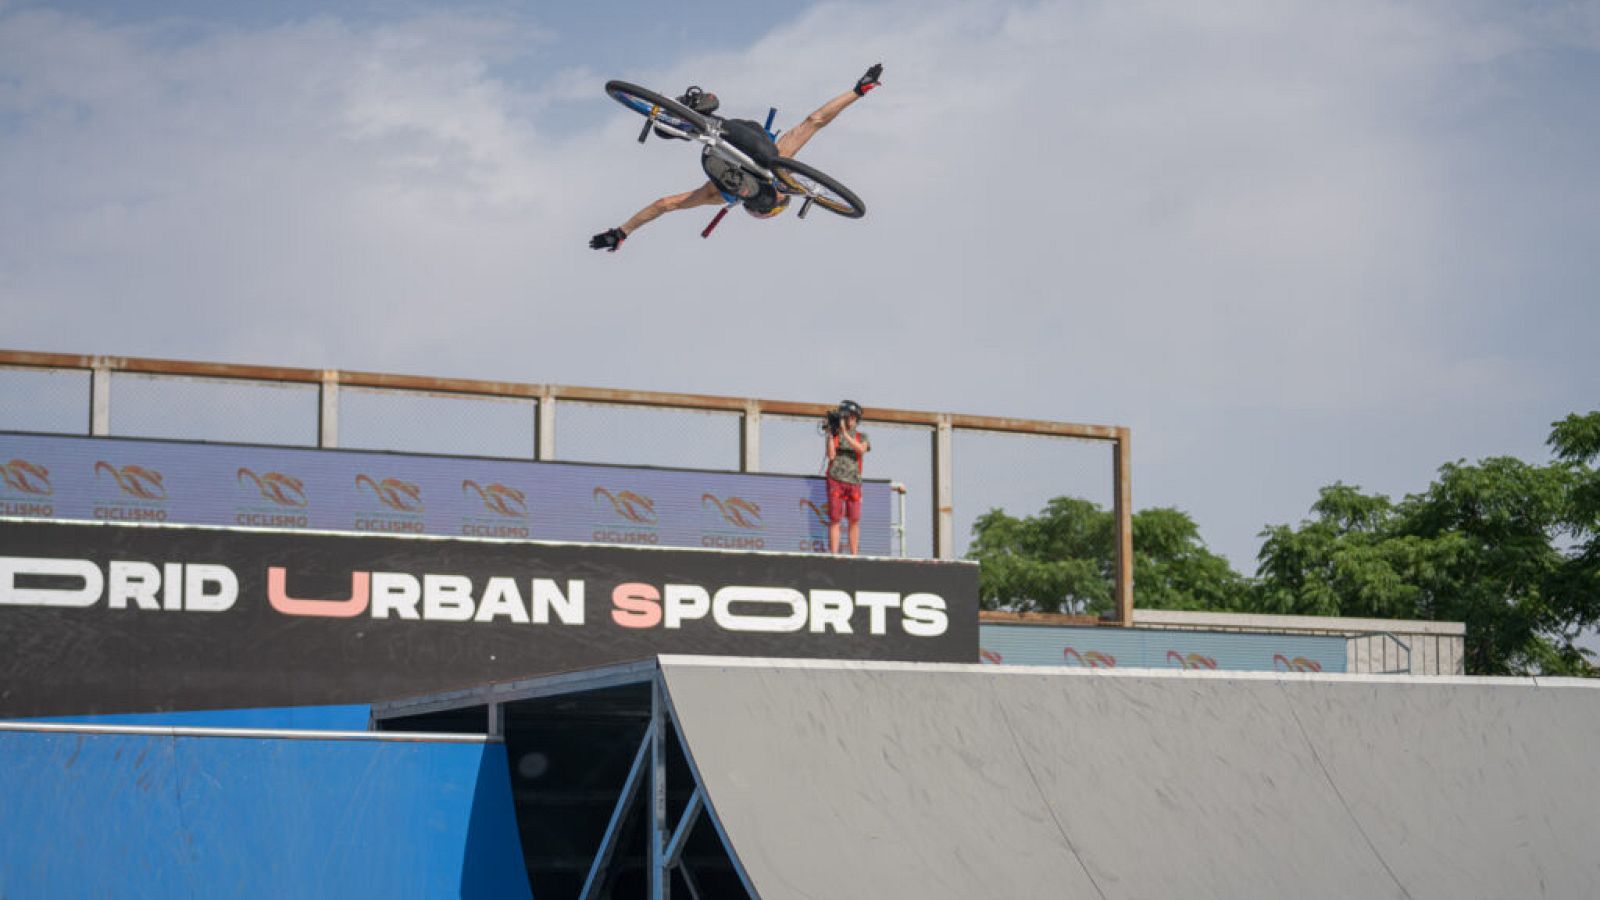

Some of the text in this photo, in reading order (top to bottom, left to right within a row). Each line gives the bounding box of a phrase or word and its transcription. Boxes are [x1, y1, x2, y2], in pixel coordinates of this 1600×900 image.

[94, 506, 167, 521] CICLISMO
[236, 512, 308, 527] CICLISMO
[354, 518, 425, 533] CICLISMO
[462, 524, 529, 538] CICLISMO
[592, 530, 660, 544] CICLISMO
[701, 535, 765, 549] CICLISMO
[267, 565, 586, 626] URBAN
[611, 582, 950, 638] SPORTS
